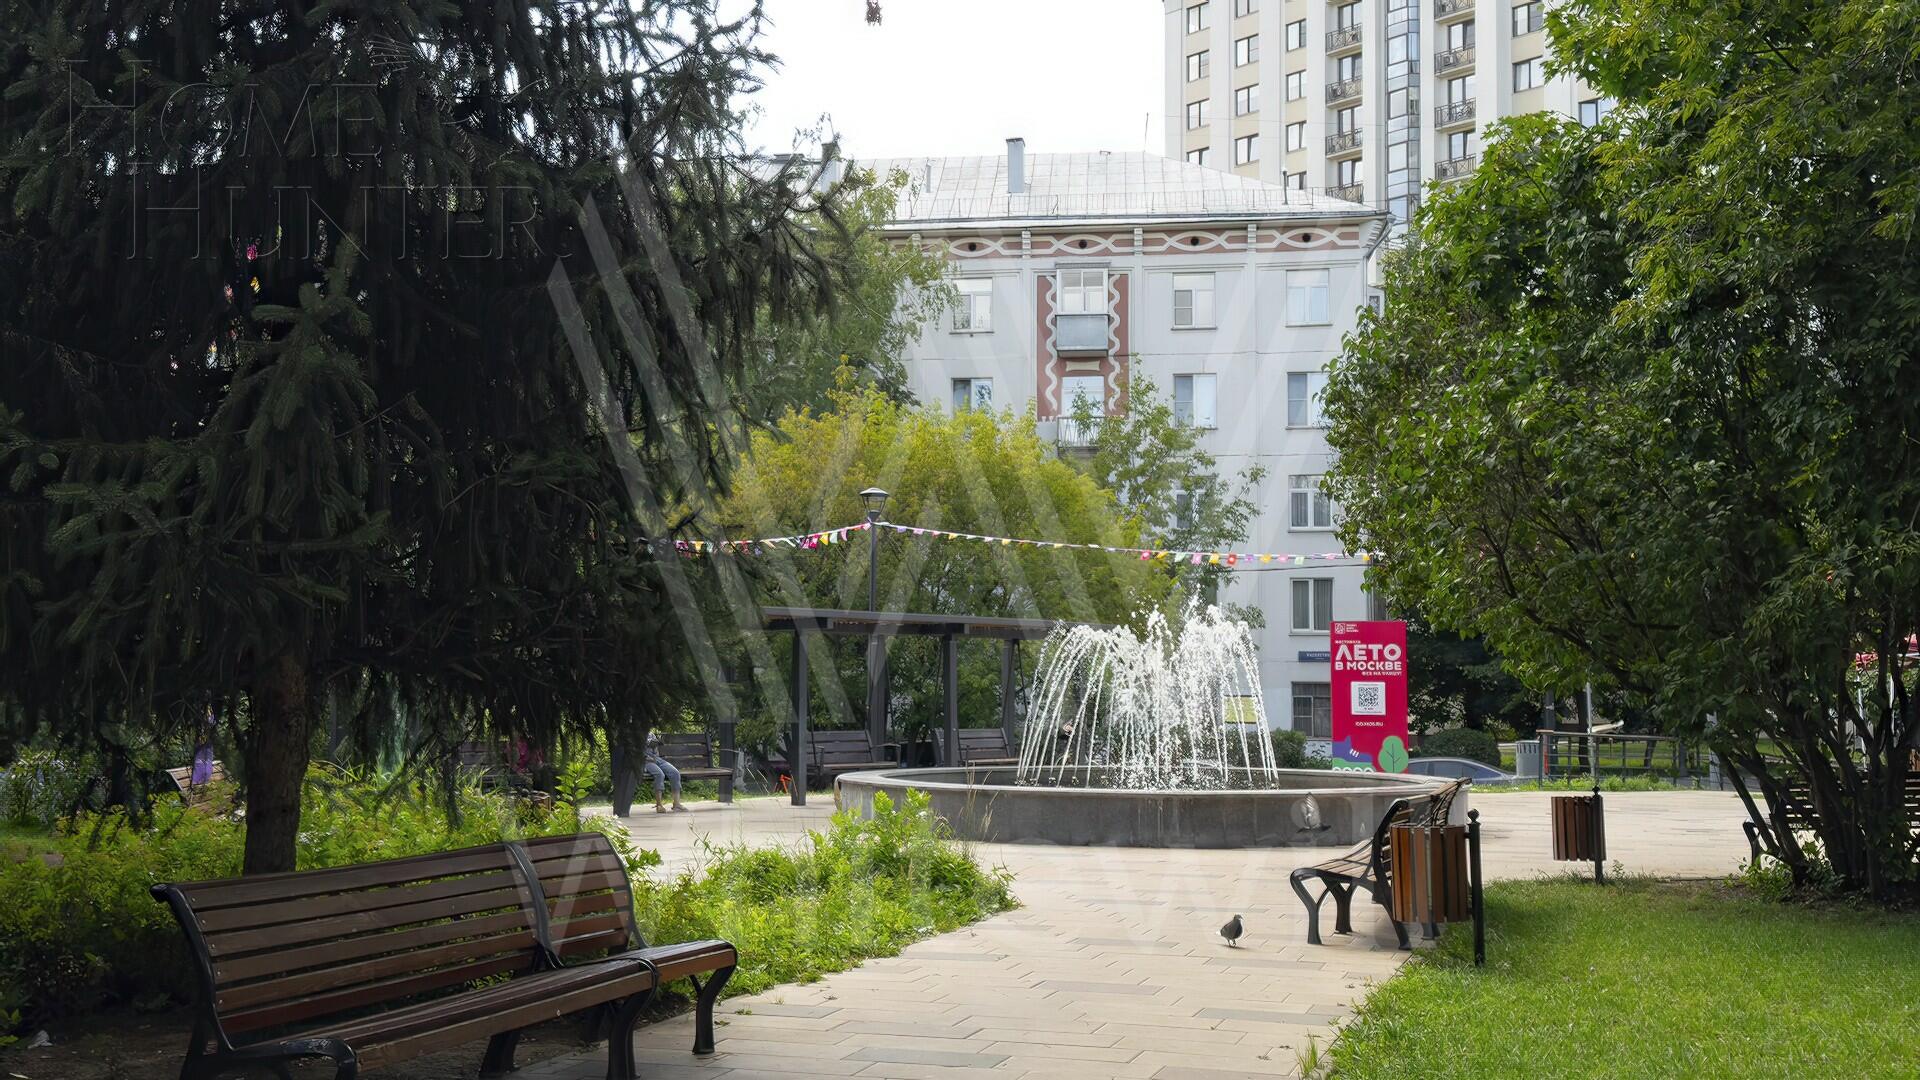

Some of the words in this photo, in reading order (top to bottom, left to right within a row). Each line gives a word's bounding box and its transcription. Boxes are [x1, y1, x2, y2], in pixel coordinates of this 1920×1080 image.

[1335, 643, 1402, 661] ЛЕТО
[1335, 661, 1344, 671] В
[1346, 661, 1402, 671] МОСКВЕ
